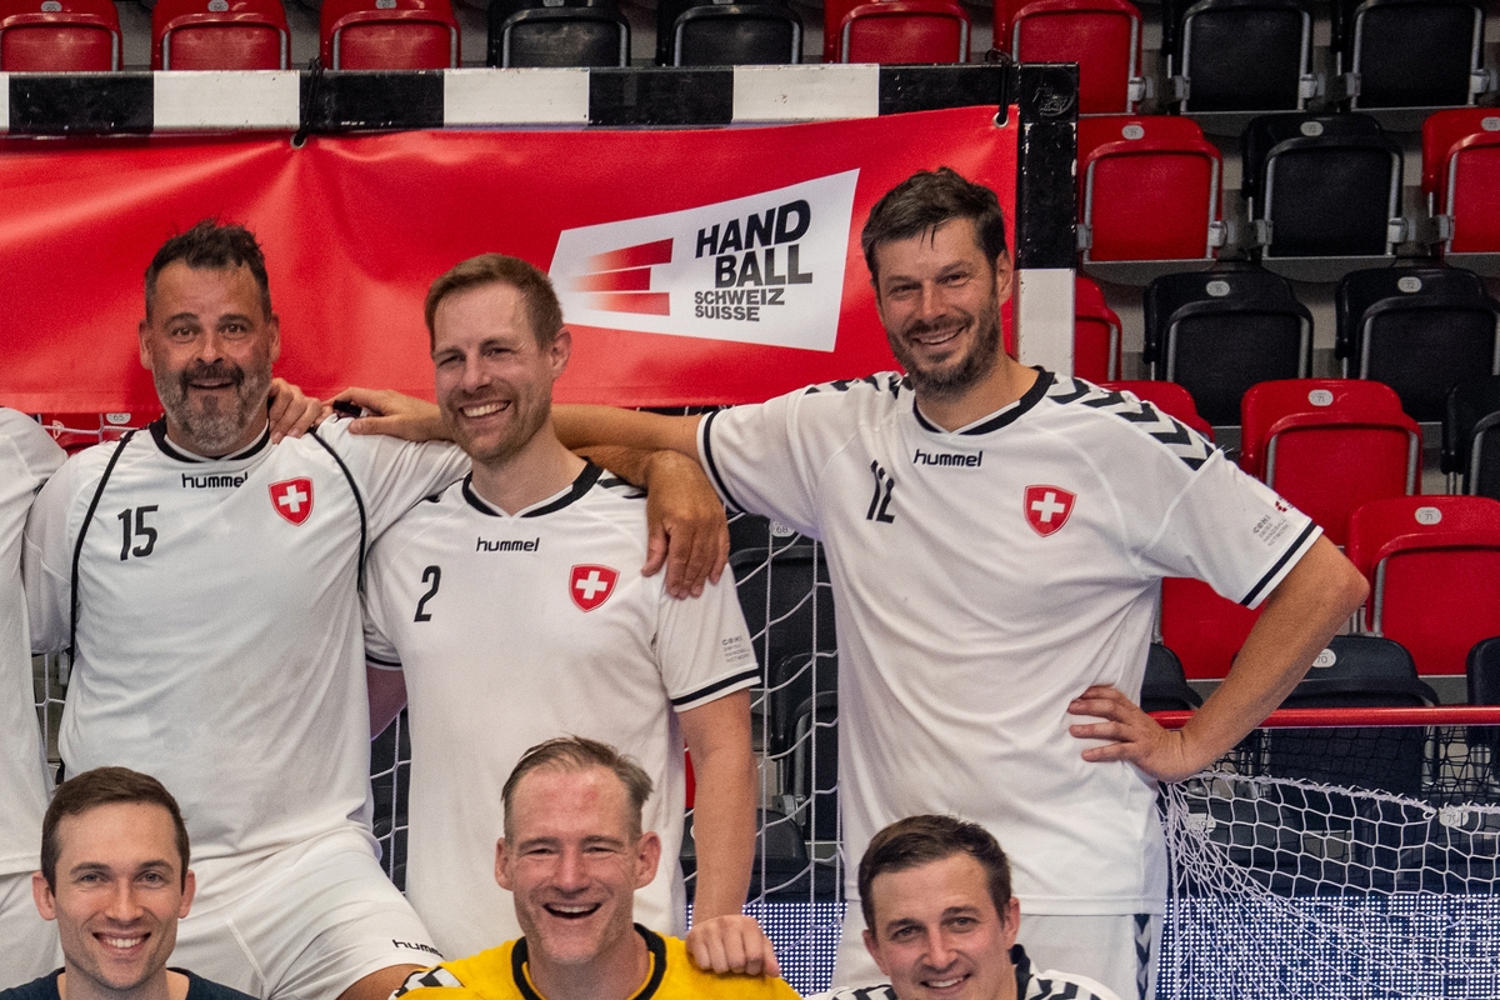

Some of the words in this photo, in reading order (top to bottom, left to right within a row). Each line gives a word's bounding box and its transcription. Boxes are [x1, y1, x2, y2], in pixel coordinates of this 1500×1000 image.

[695, 199, 811, 258] HAND
[715, 243, 813, 288] BALL
[695, 287, 785, 306] SCHWEIZ
[695, 304, 760, 322] SUISSE
[913, 448, 983, 467] hummel
[866, 459, 896, 524] 12
[117, 504, 159, 562] 15
[1425, 513, 1435, 521] 71
[476, 537, 540, 552] hummel
[413, 565, 442, 623] 2
